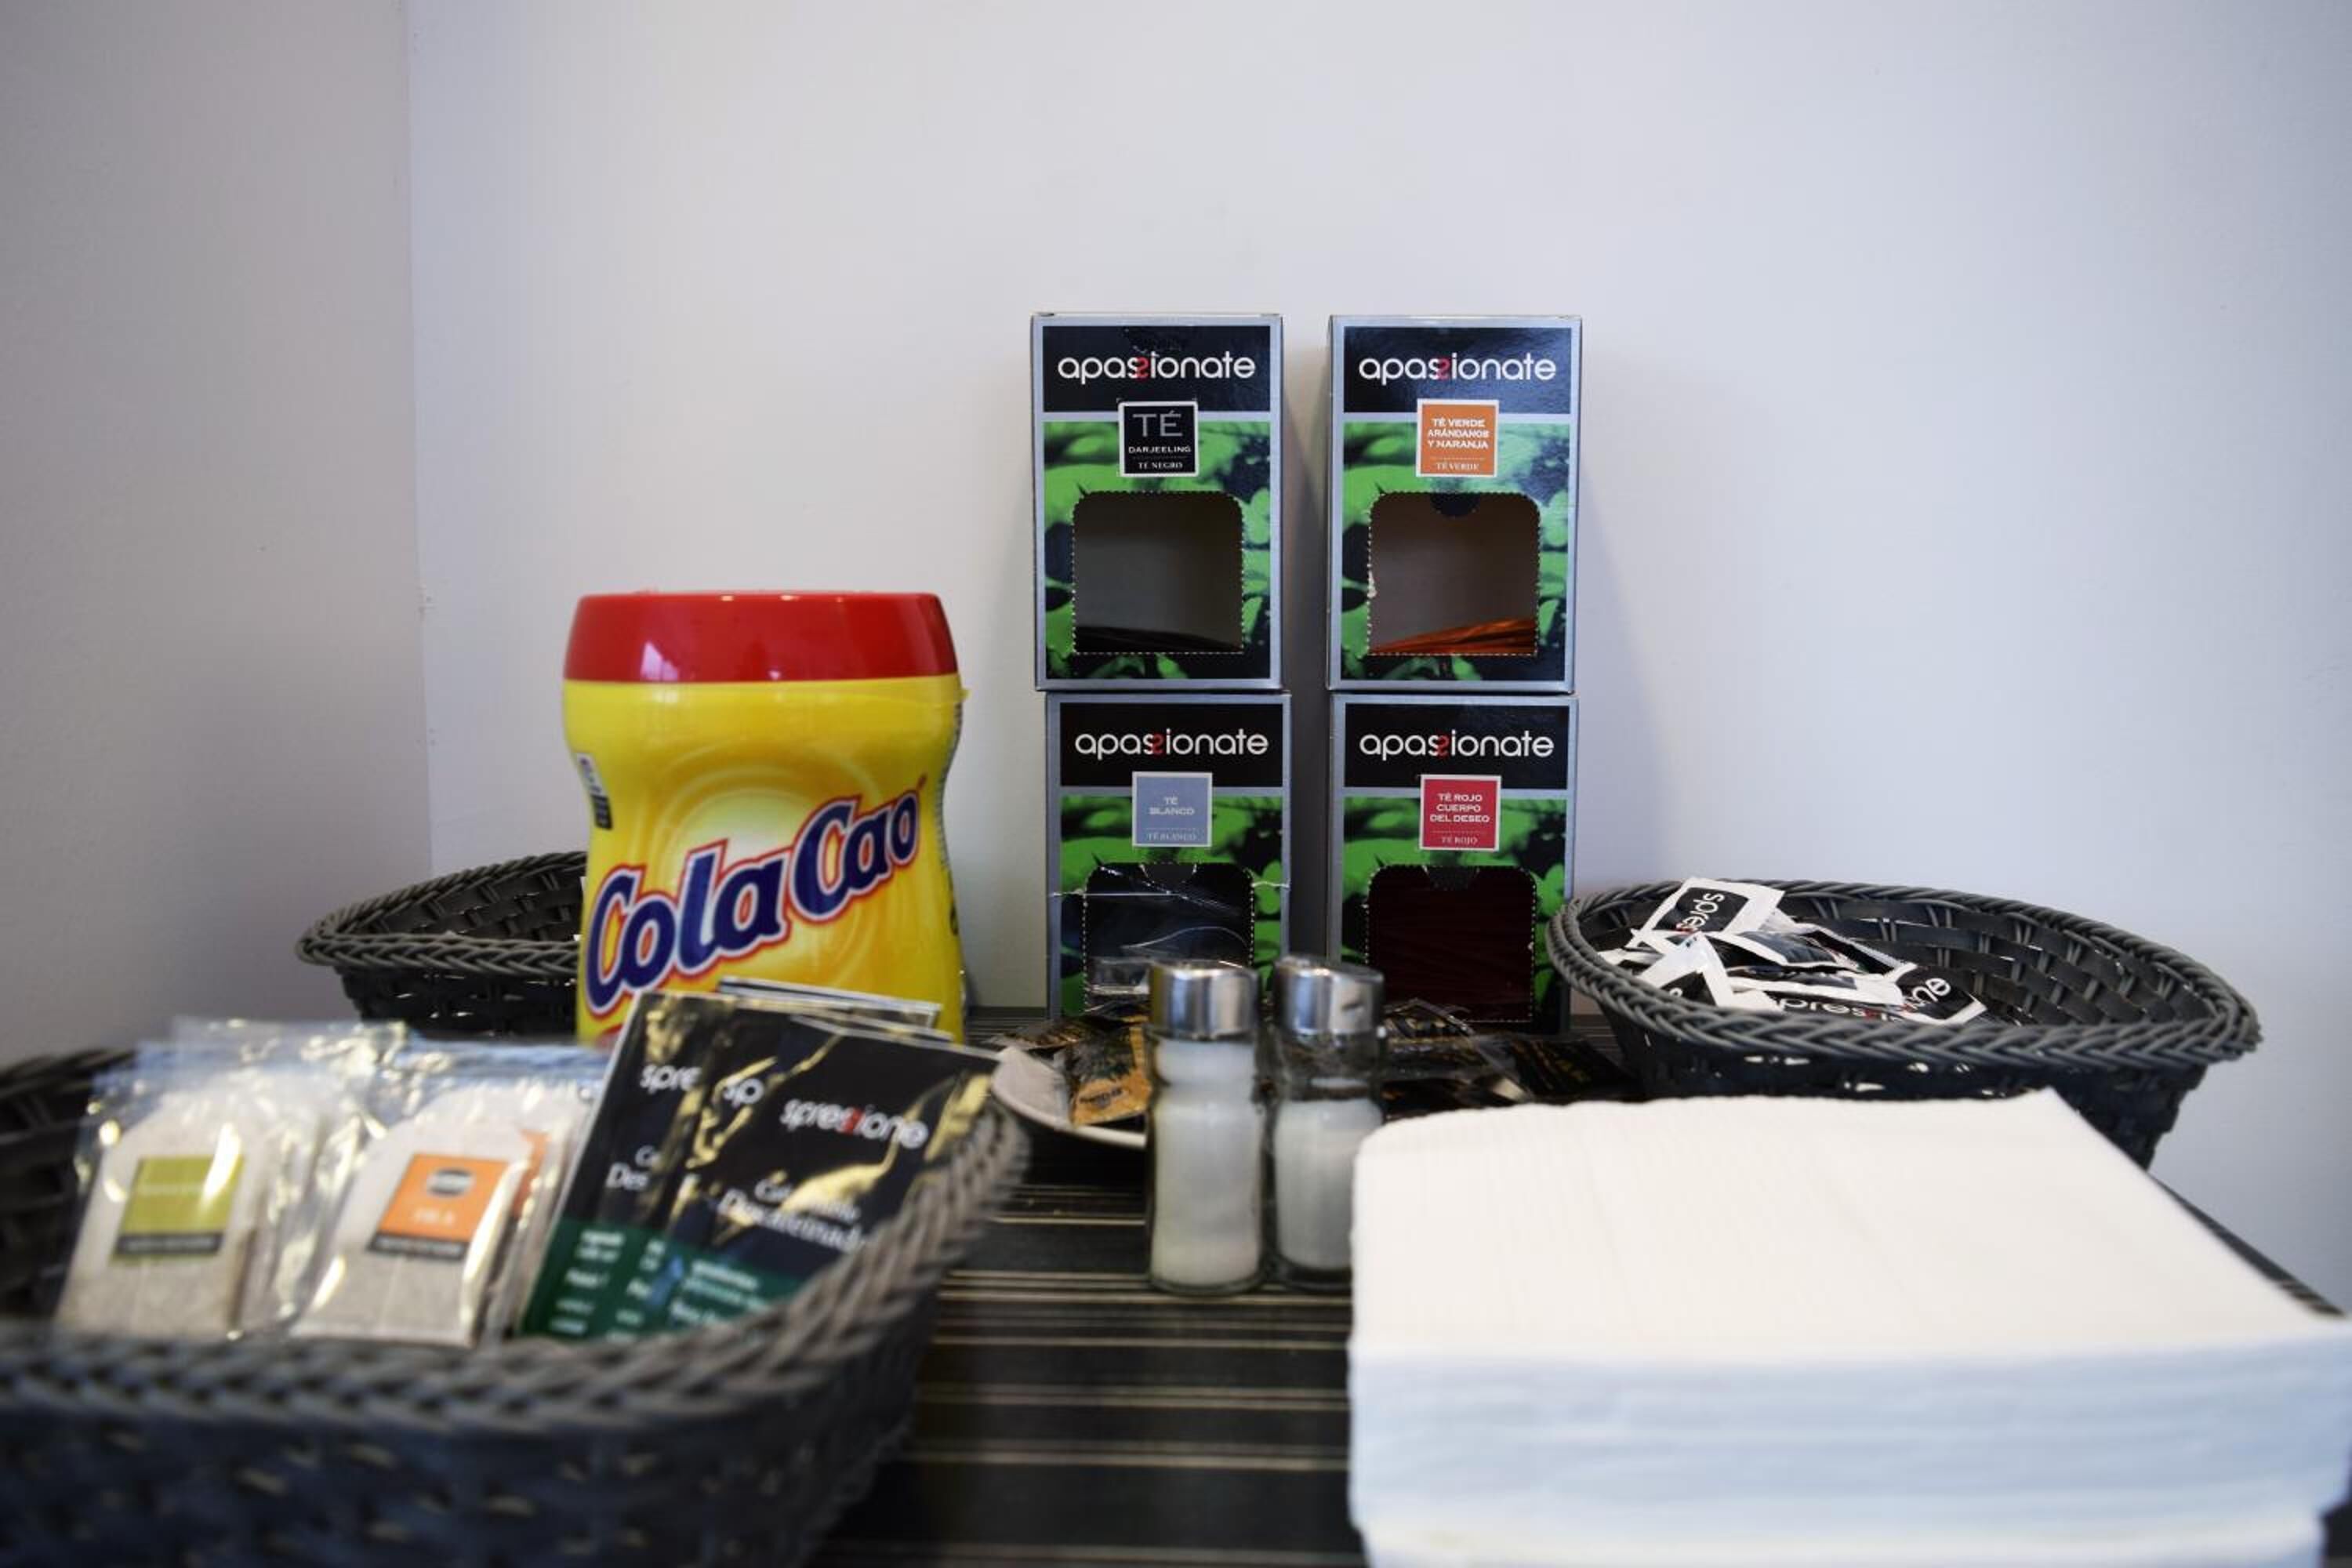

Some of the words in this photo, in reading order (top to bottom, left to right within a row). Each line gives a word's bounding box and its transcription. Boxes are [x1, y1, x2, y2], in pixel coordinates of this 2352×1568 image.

[1132, 409, 1183, 437] TÉ
[1448, 417, 1486, 428] VERDE
[1428, 428, 1490, 438] ARÁNDANOS
[1128, 445, 1192, 454] DARJEELING
[1428, 440, 1434, 448] Y
[1436, 440, 1489, 450] NARANJA
[1151, 461, 1183, 470] NEGRO
[1454, 793, 1483, 802] ROJO
[1149, 807, 1196, 816] BLANCO
[1436, 804, 1481, 813] CUERPO
[1430, 814, 1452, 823] DEL
[1453, 815, 1490, 823] DESEO
[1454, 837, 1479, 845] ROJO
